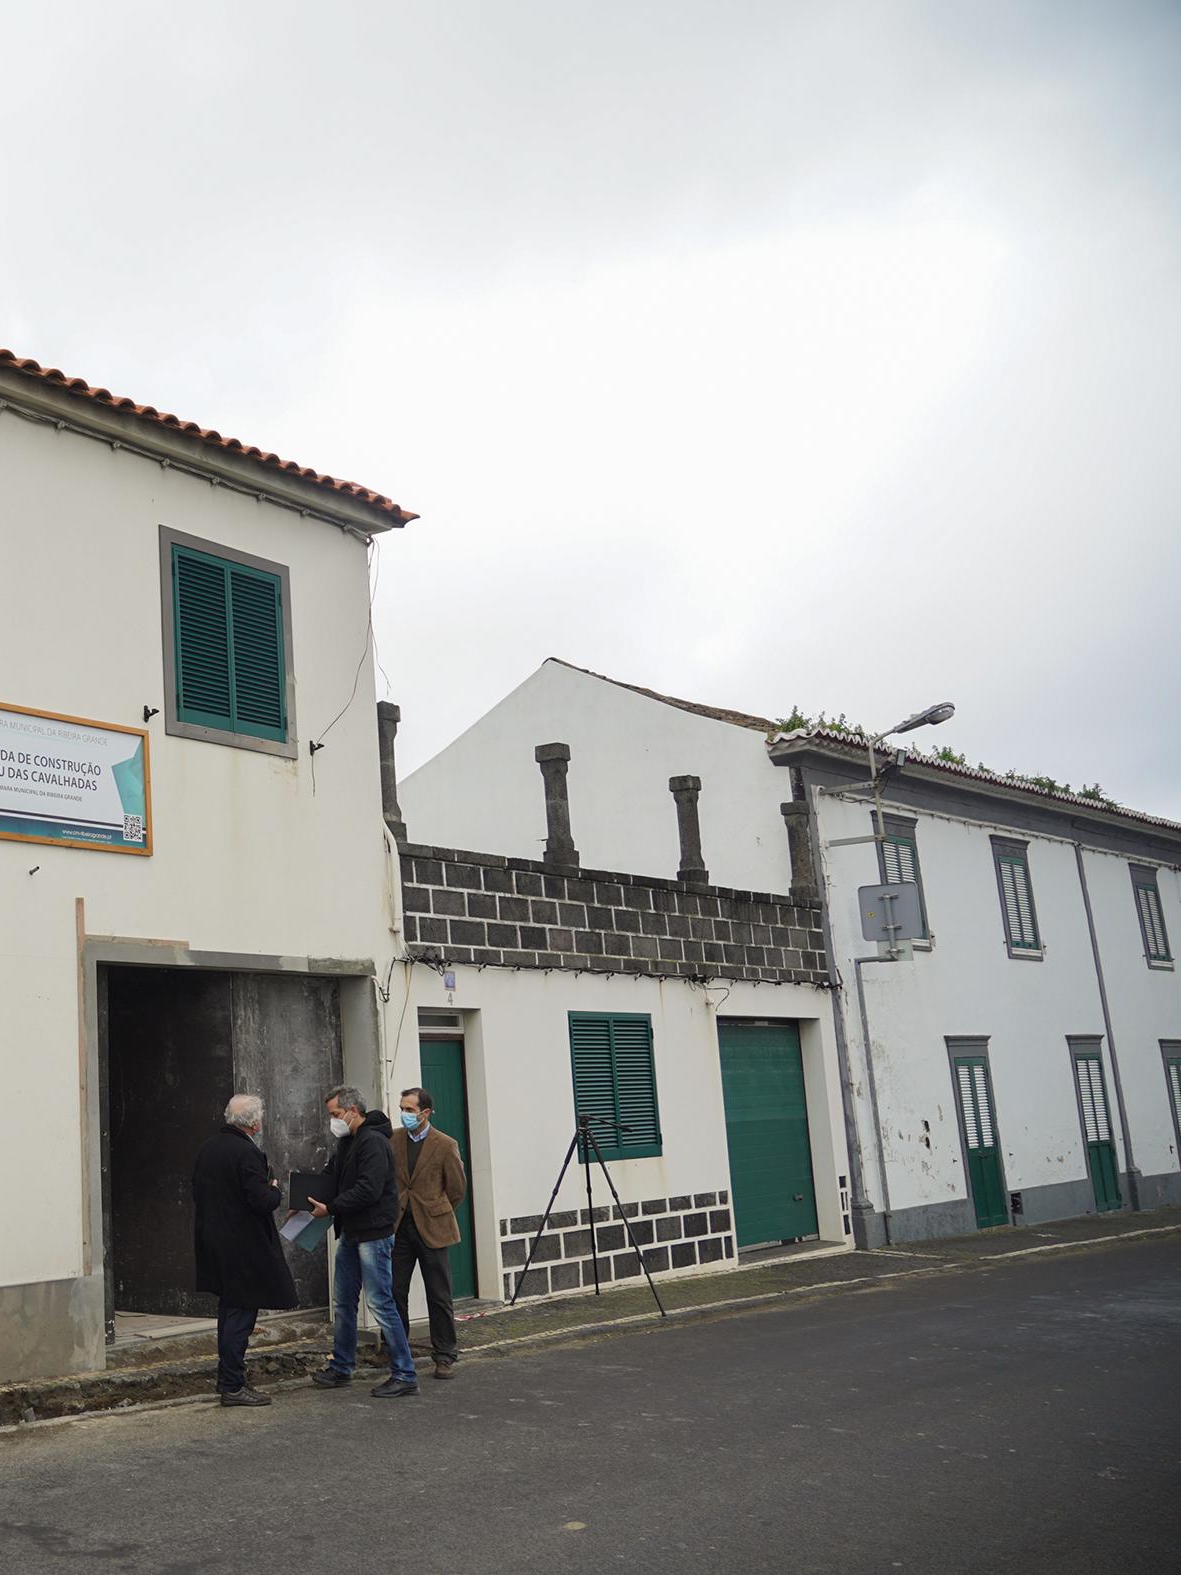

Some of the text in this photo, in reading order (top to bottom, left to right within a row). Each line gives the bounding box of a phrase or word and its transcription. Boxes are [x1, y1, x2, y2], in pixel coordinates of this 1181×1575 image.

[10, 721, 45, 736] MUNICIPAL
[47, 728, 57, 736] DA
[58, 730, 81, 741] RIBEIRA
[82, 734, 107, 746] GRANDE
[18, 752, 31, 765] DE
[34, 755, 101, 776] CONSTRUÇÃO
[8, 767, 29, 781] DAS
[31, 771, 97, 791] CAVALHADAS
[14, 787, 39, 796] MUNICIPAL
[47, 791, 63, 799] RIBEIRA
[64, 794, 83, 802] GRANDE
